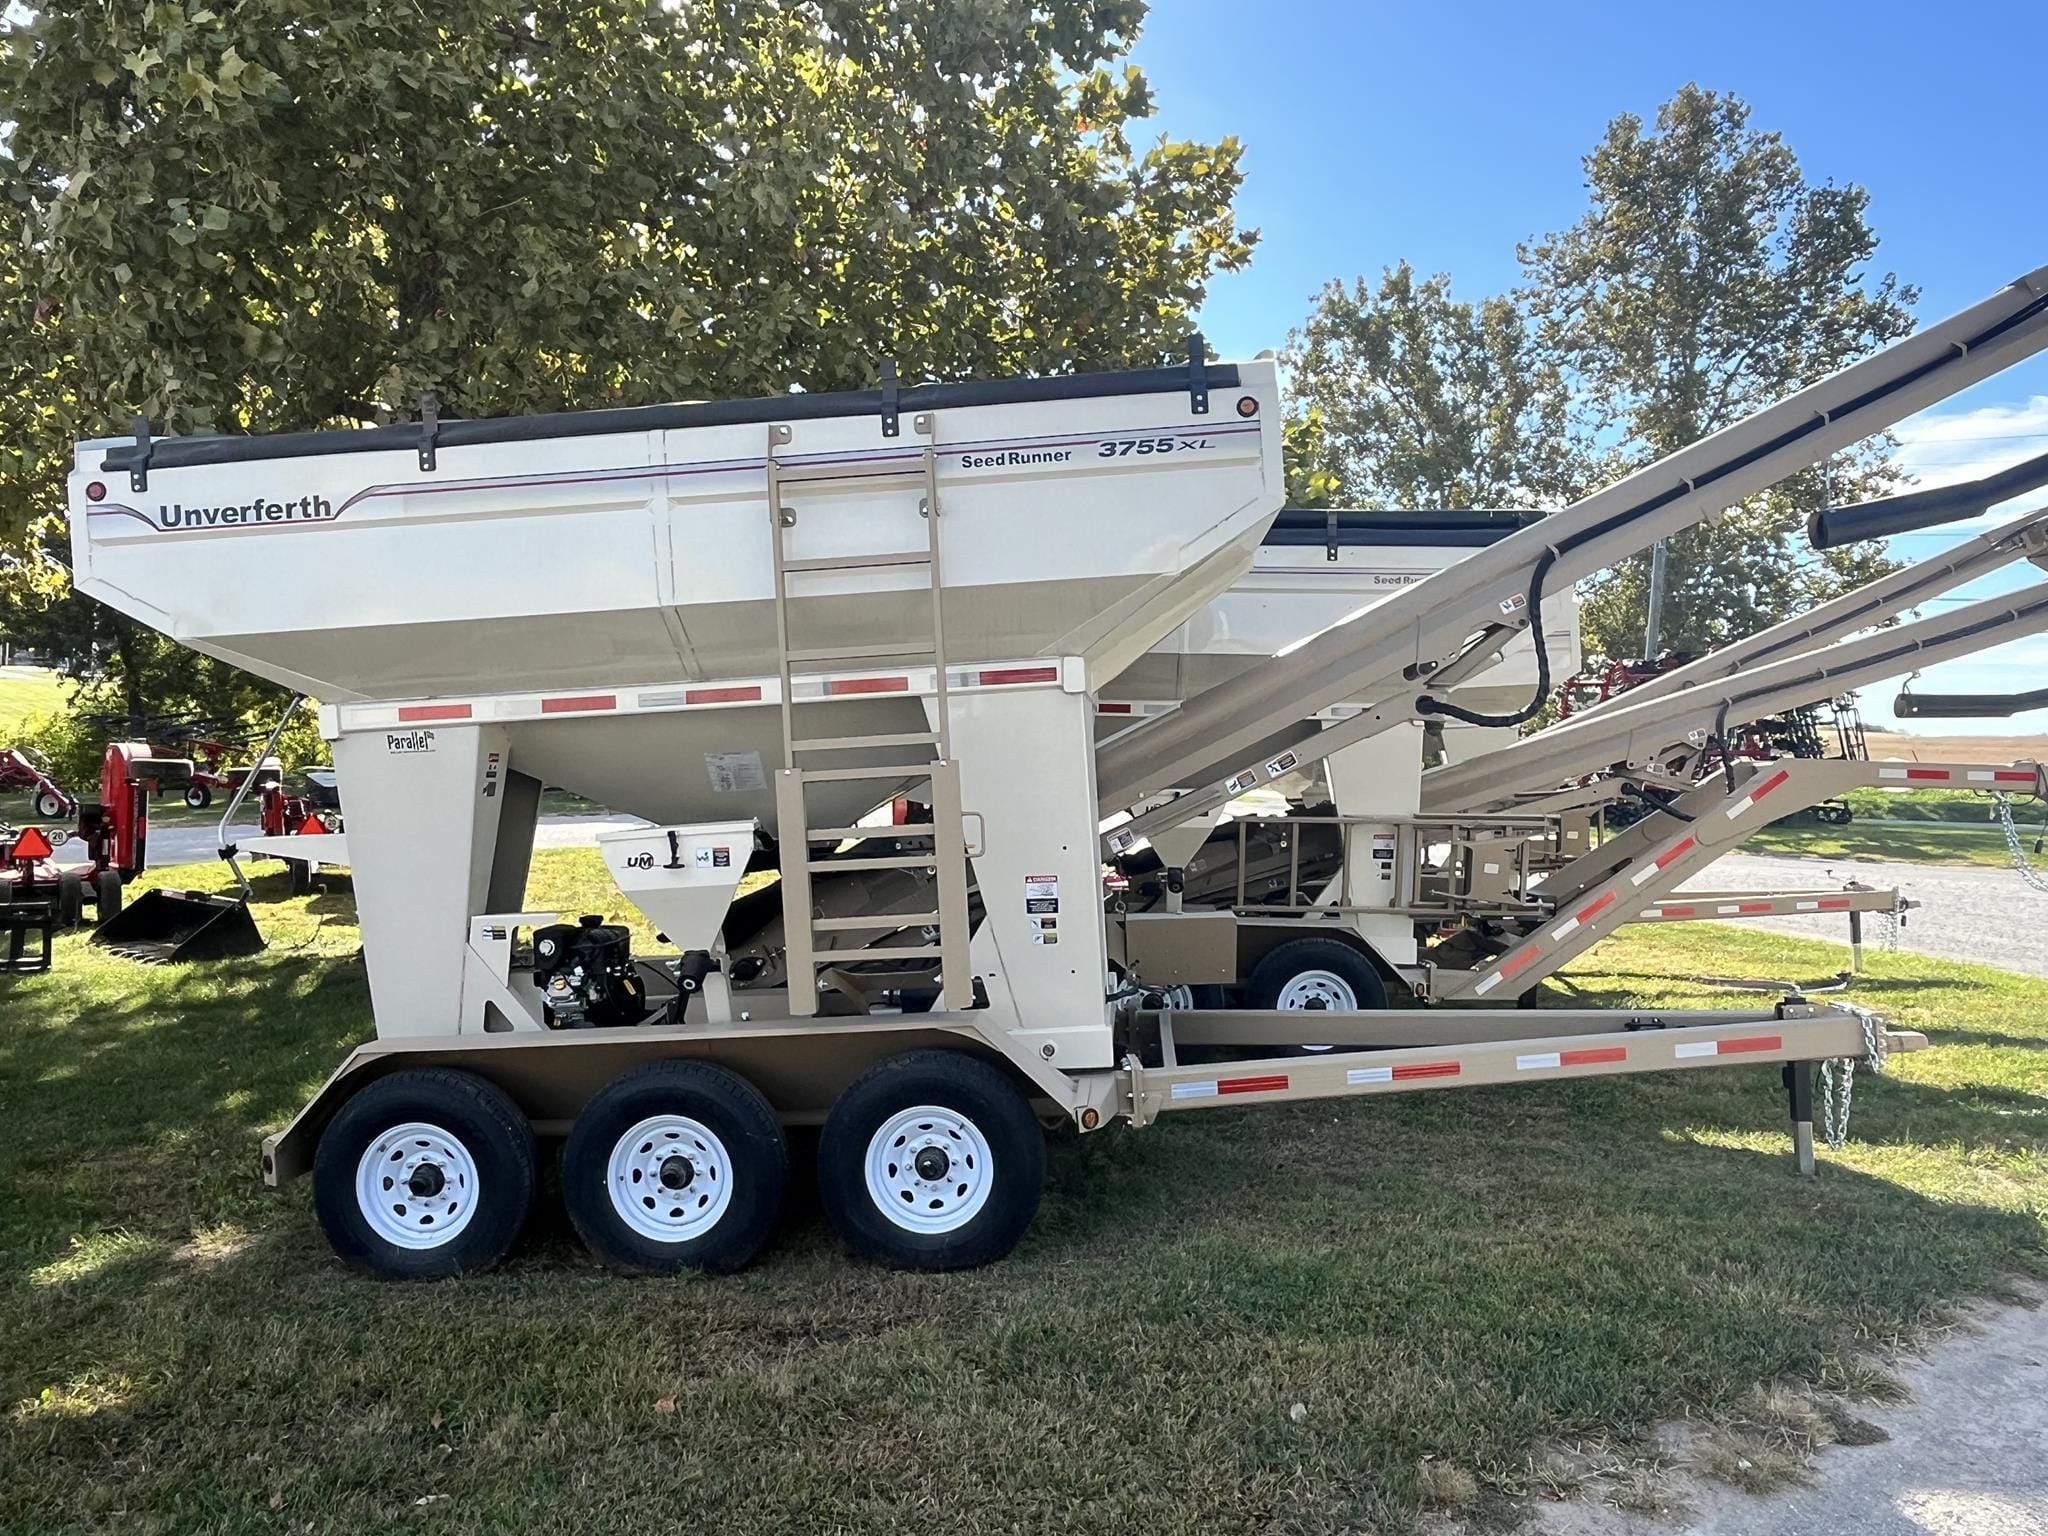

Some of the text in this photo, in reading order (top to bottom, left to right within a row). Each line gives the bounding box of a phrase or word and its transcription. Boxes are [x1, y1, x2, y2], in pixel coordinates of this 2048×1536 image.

[961, 450, 1072, 468] Seed Runner
[160, 495, 331, 527] Unverferth
[1374, 575, 1401, 584] Seed
[387, 730, 429, 750] Parallel
[52, 831, 64, 840] 20
[627, 852, 654, 870] UM
